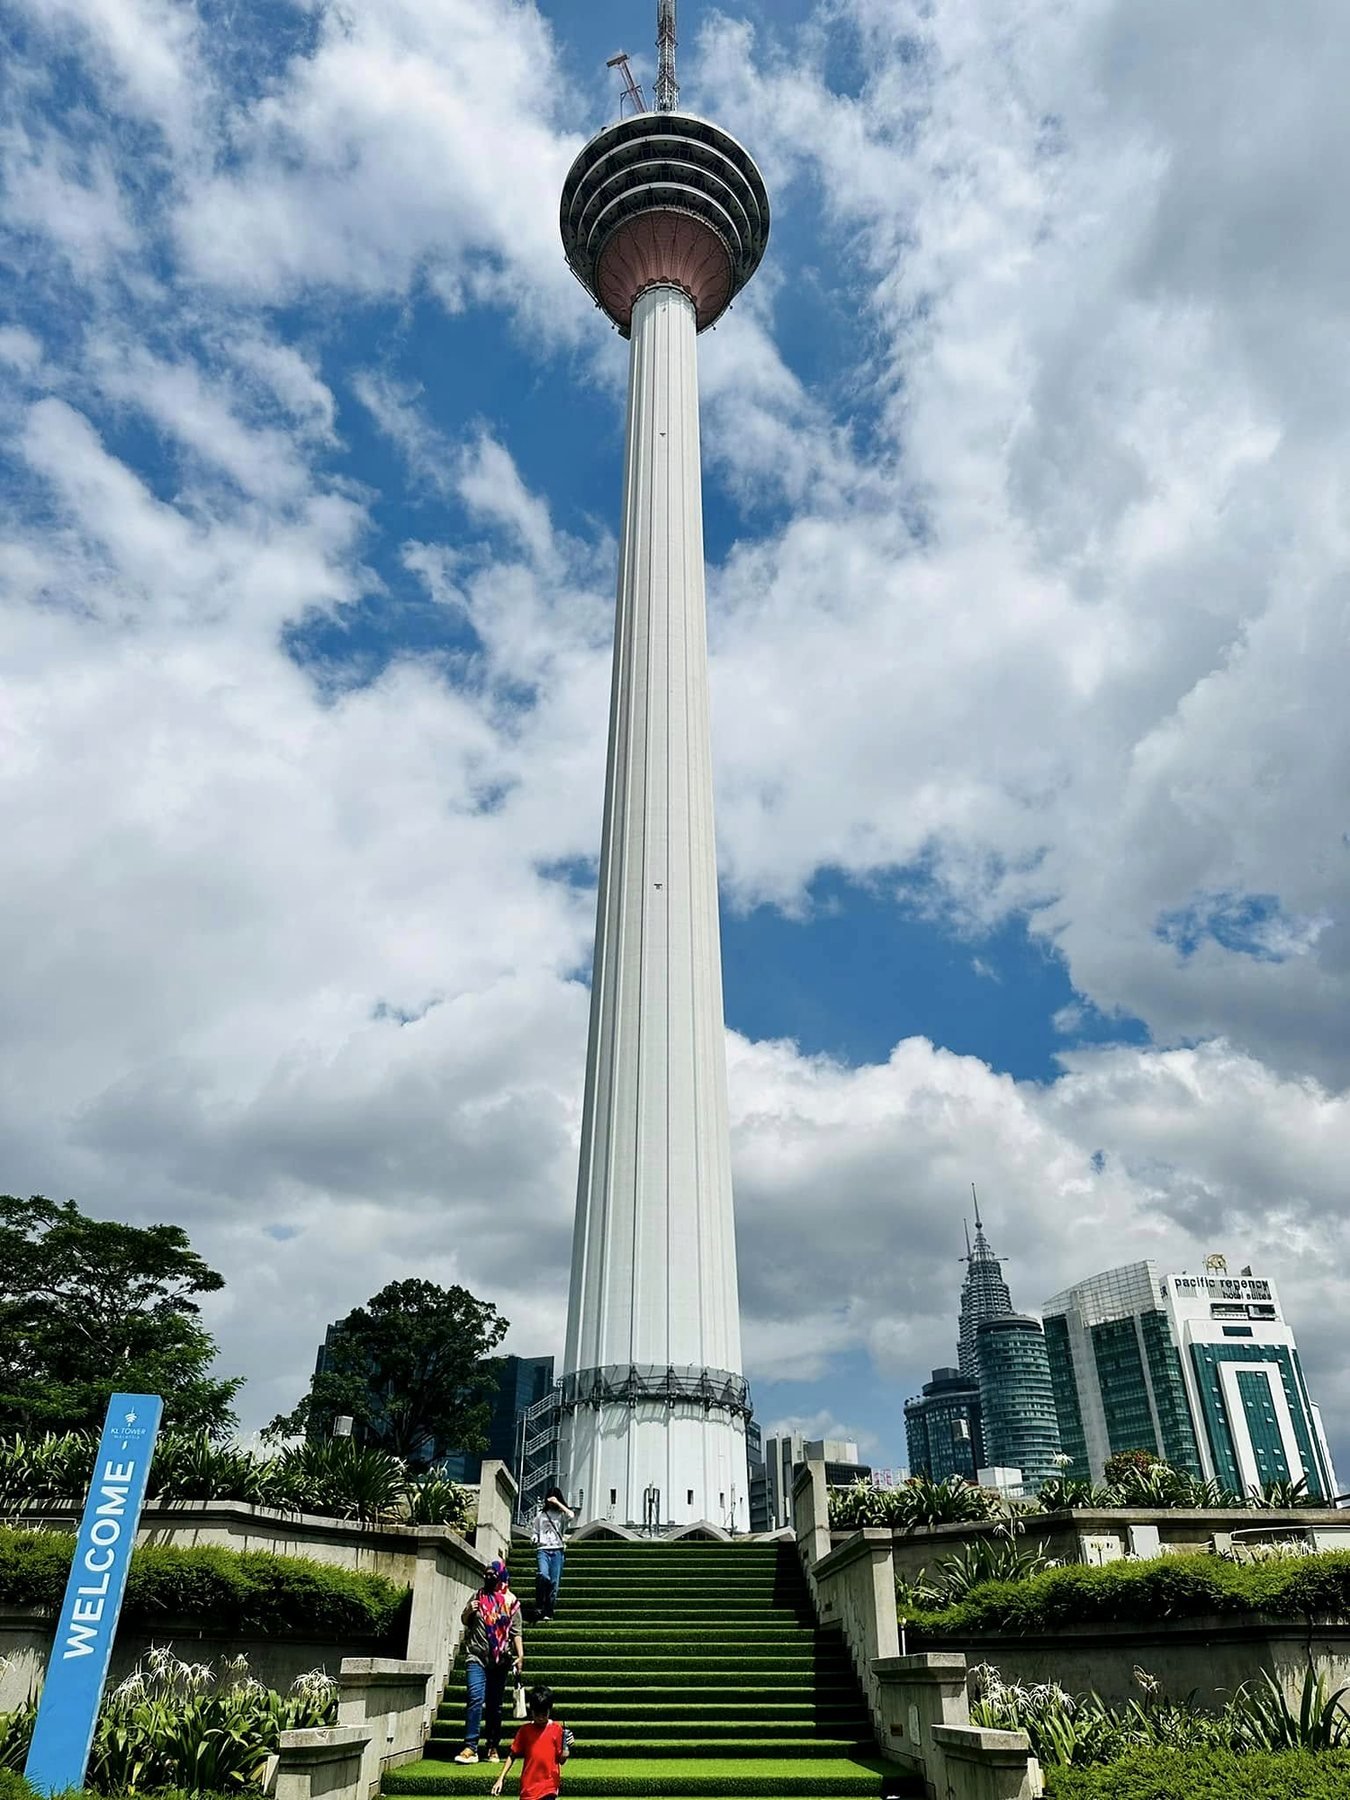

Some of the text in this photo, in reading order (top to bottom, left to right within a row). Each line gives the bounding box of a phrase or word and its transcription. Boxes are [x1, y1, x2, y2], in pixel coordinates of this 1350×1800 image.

[1174, 1276, 1269, 1291] pacific regency
[121, 1427, 147, 1435] TOWER
[63, 1460, 135, 1660] WELCOME
